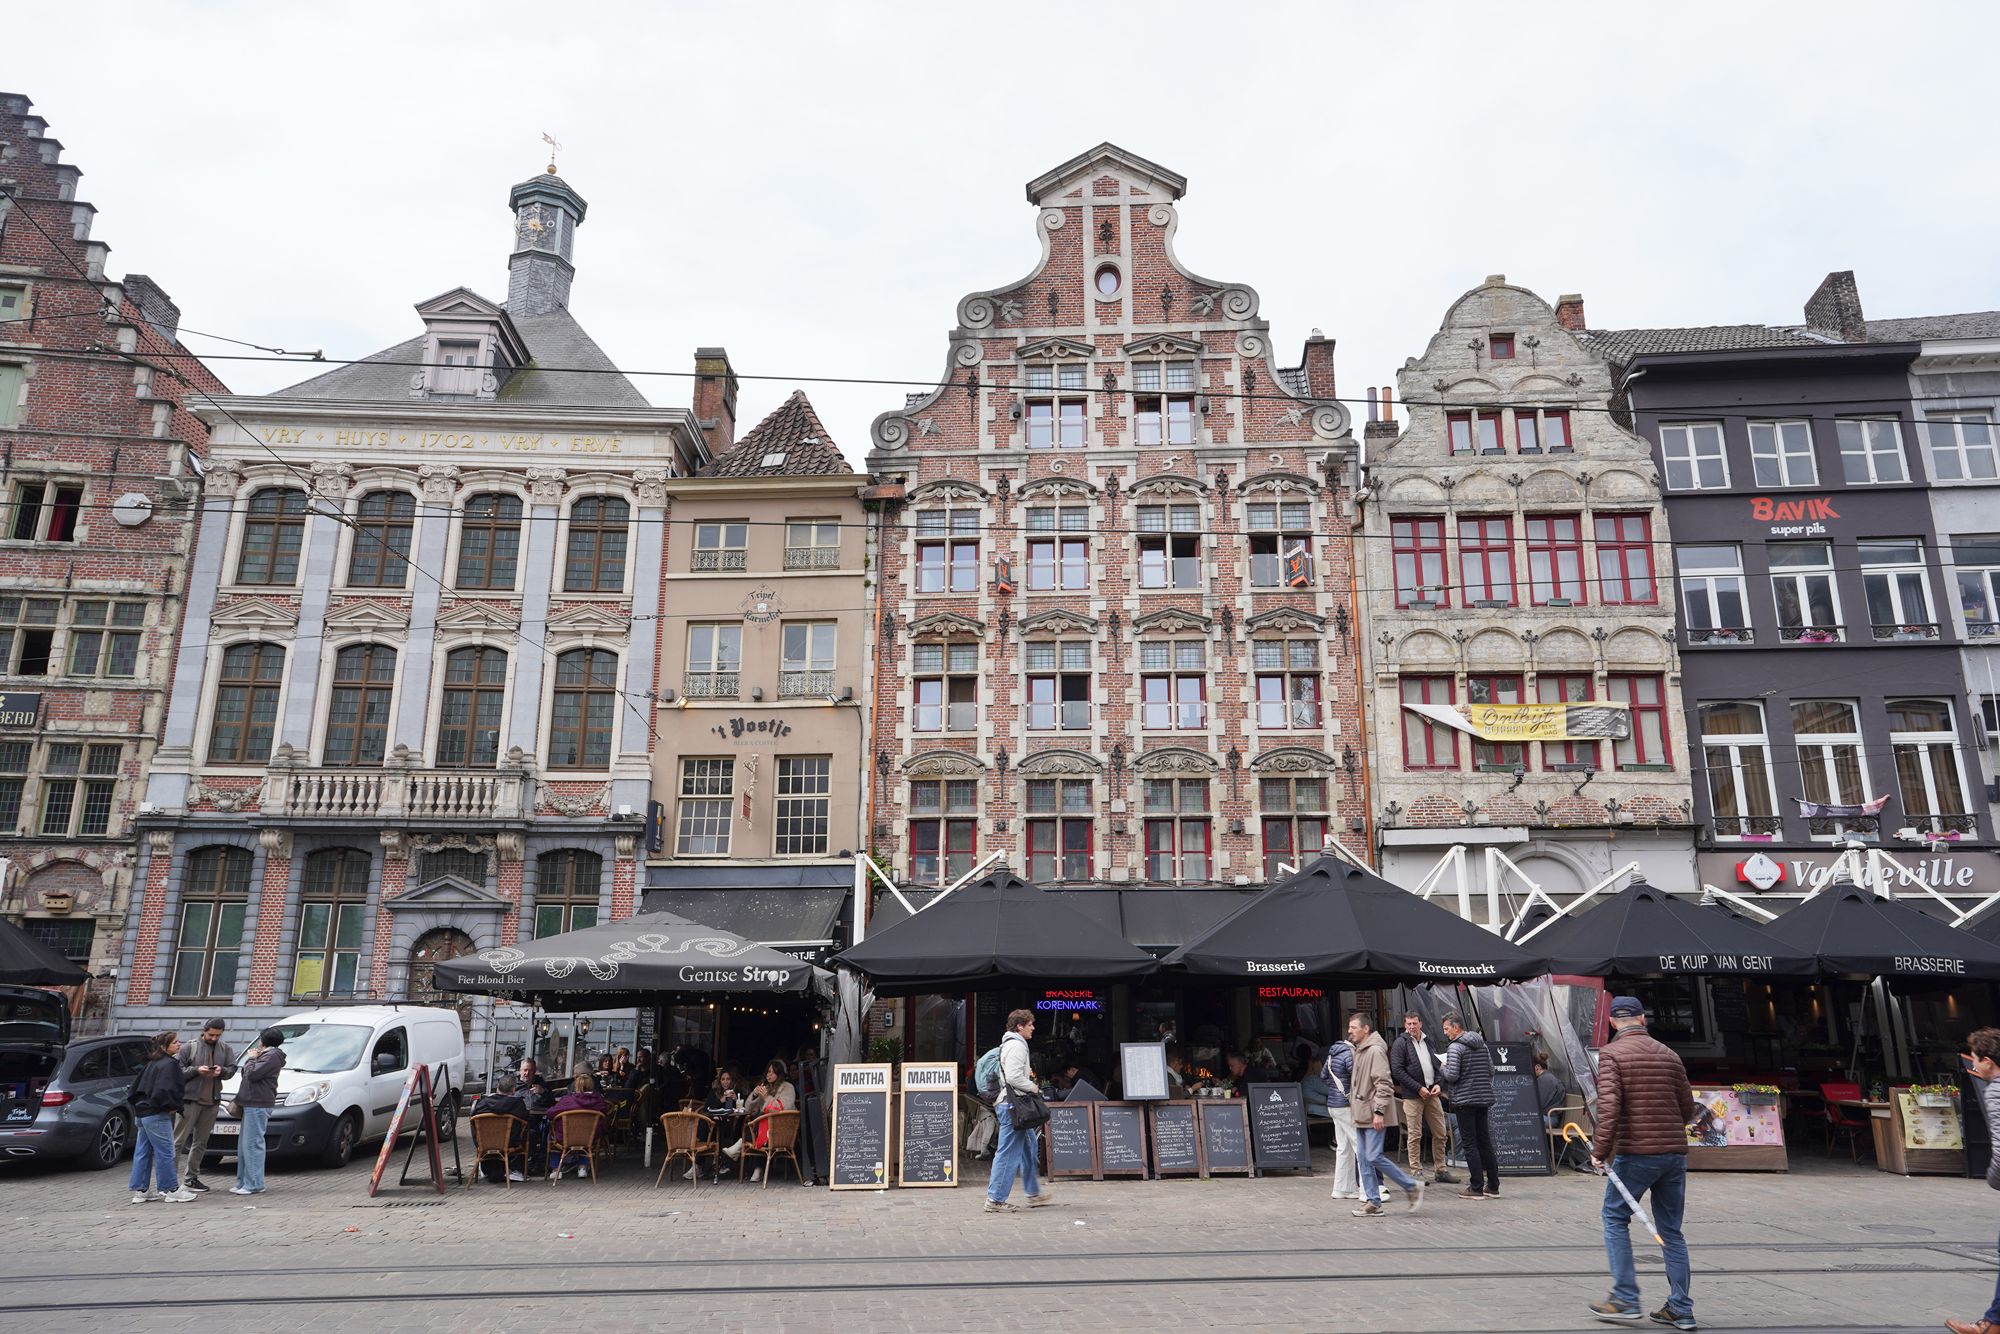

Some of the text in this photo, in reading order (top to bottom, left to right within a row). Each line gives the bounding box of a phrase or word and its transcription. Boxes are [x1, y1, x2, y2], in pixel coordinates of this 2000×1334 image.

[261, 428, 622, 452] VRY HUYS 1702 VRY ERVE
[1750, 497, 1840, 521] BAVIK
[1771, 522, 1826, 536] super pils
[748, 591, 775, 600] Tripel
[729, 717, 792, 738] Postje
[1791, 858, 1974, 887] Vadeville
[1247, 961, 1306, 973] Brasserie
[1418, 961, 1496, 975] Korenmarkt
[1659, 955, 1773, 970] DE KUIP VAN GENT
[1894, 957, 1965, 974] BRASSERIE
[458, 975, 525, 985] Fier Blond Bier
[679, 965, 790, 987] Gentse Strop
[841, 1072, 884, 1085] MARTHA
[907, 1071, 951, 1084] MARTHA
